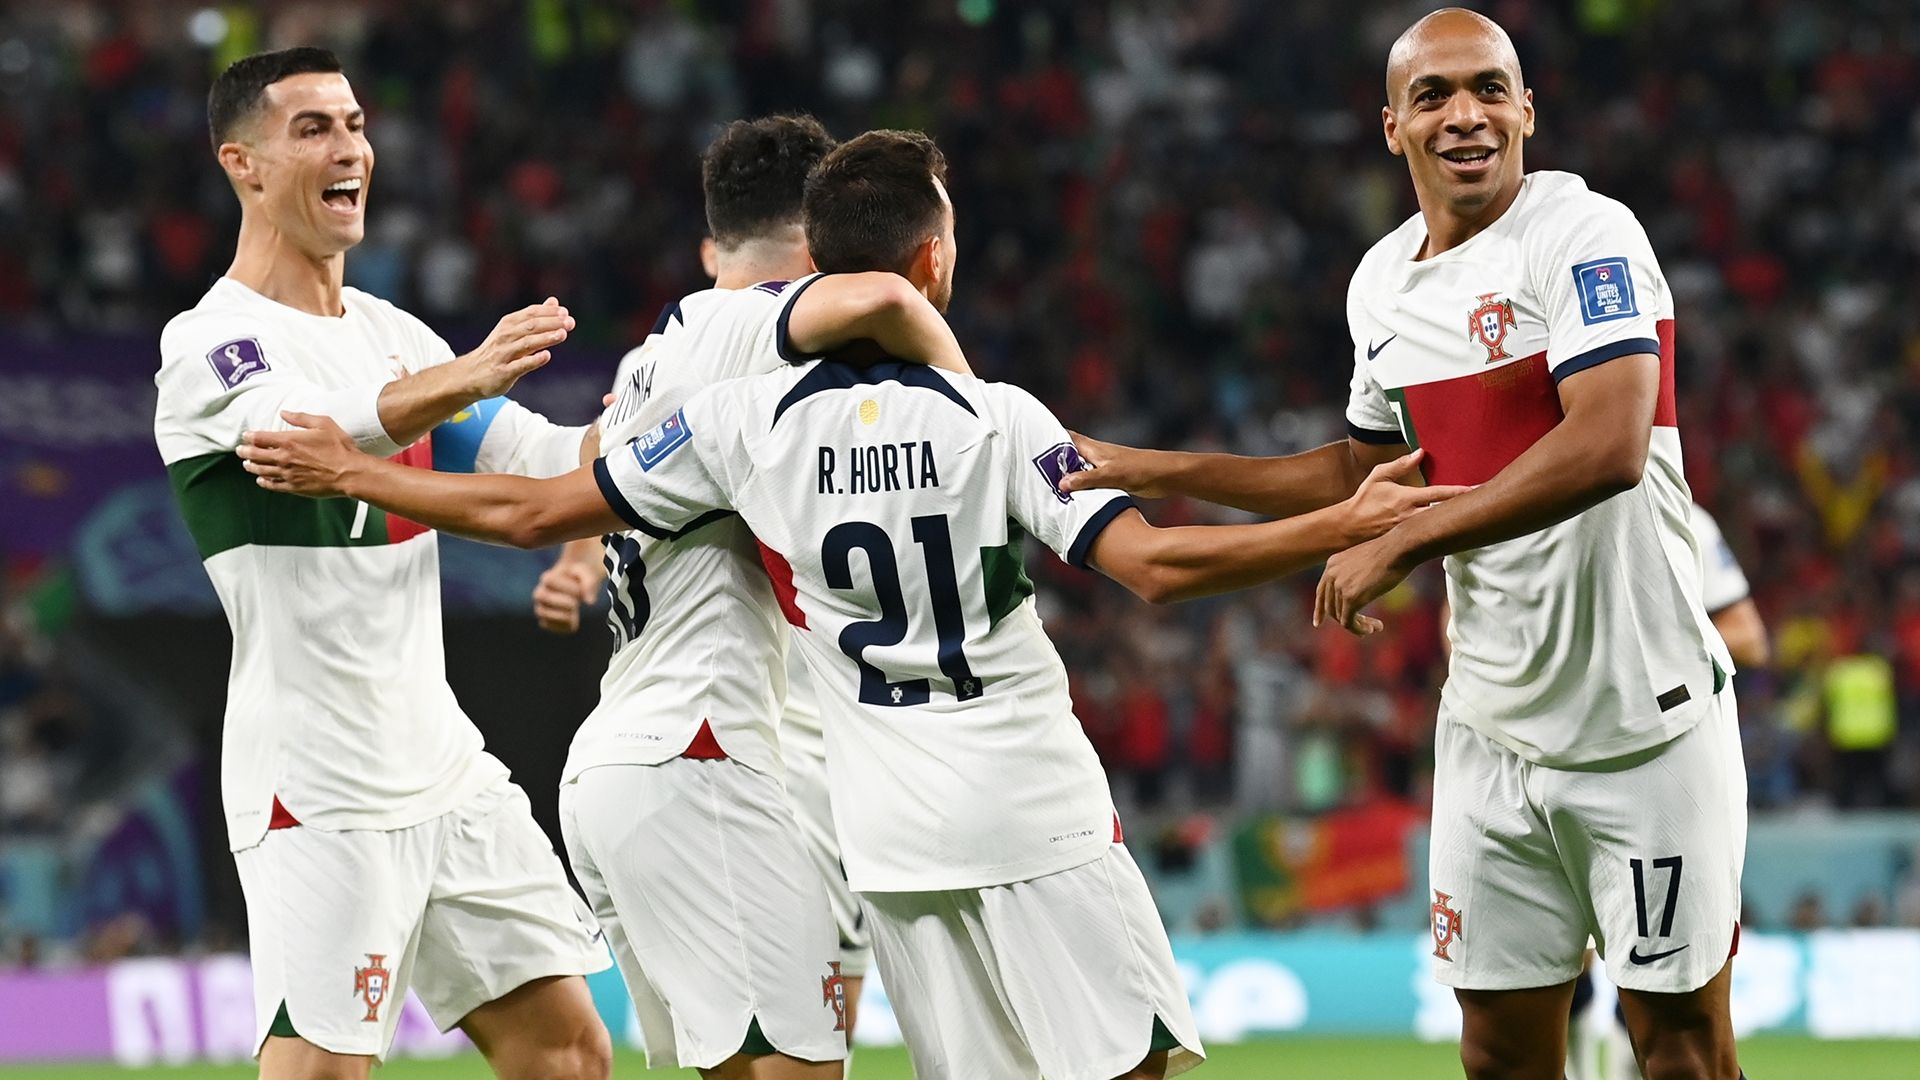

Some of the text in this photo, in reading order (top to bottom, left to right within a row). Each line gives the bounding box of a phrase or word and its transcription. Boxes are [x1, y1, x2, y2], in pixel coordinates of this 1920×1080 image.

[850, 441, 939, 494] HORTA
[821, 514, 983, 707] 21
[1629, 855, 1682, 938] 17
